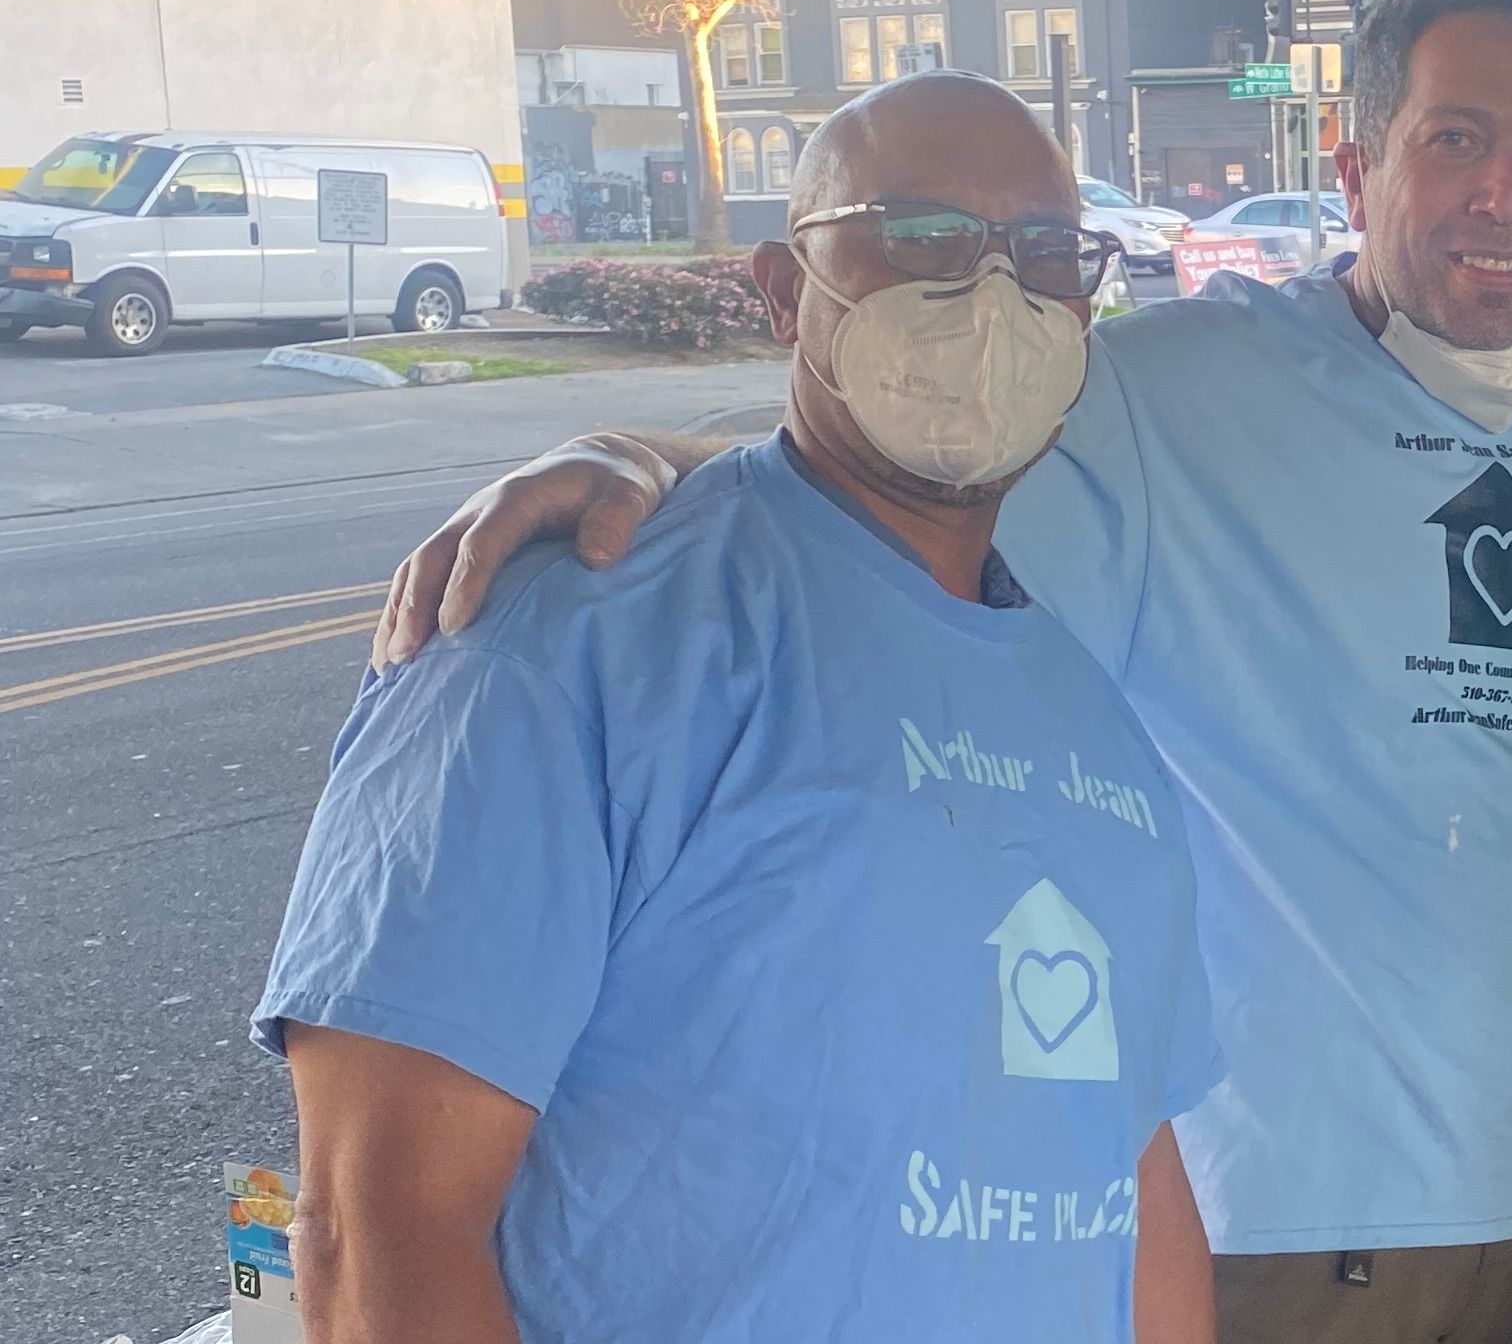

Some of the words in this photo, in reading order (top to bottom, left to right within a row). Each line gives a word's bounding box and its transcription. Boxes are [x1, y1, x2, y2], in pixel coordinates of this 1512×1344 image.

[1180, 249, 1201, 264] Call
[1218, 246, 1236, 260] and
[1395, 432, 1456, 452] Arthur
[1405, 655, 1454, 675] Helping
[1458, 658, 1481, 675] One
[898, 716, 1034, 793] Arthur
[1057, 751, 1159, 840] Jean
[239, 1273, 256, 1294] 12
